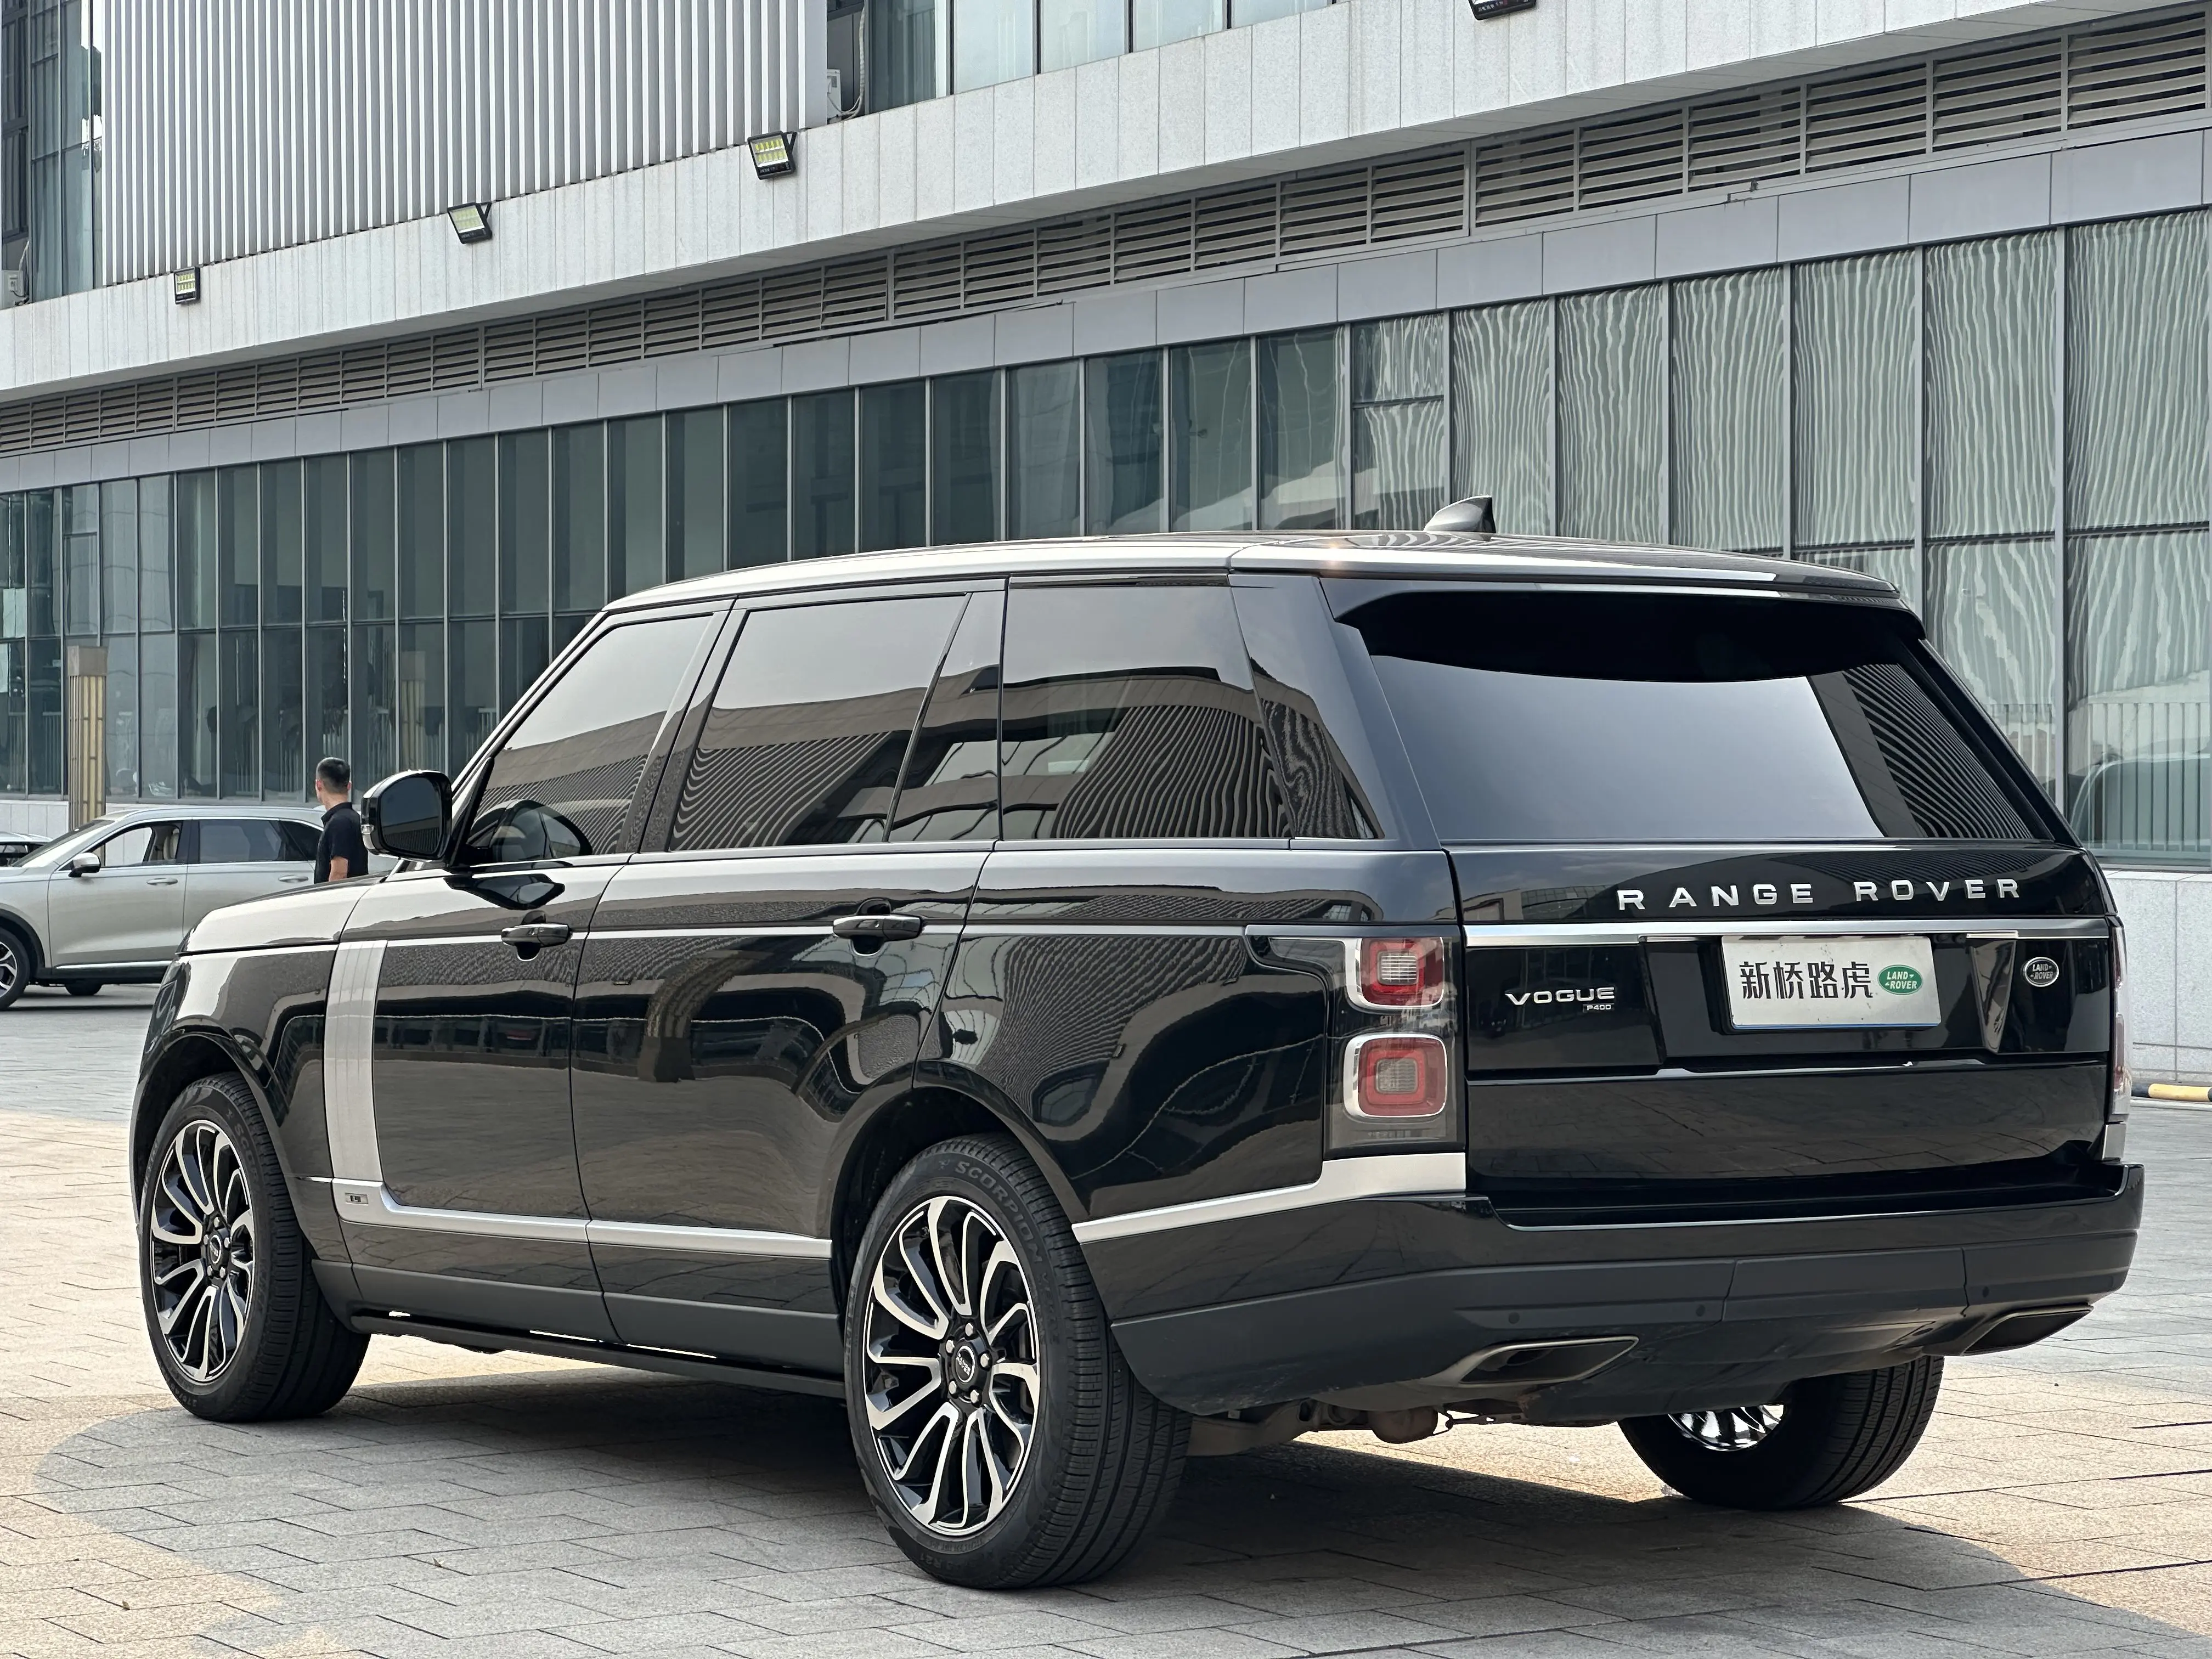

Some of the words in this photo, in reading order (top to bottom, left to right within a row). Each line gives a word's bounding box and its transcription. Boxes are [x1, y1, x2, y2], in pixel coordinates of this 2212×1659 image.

[1617, 883, 1813, 910] RANGE
[1854, 878, 2020, 902] ROVER
[1887, 971, 1909, 980] LAND
[2032, 963, 2049, 972] LAND
[1739, 961, 1873, 999] 新桥路虎
[1889, 980, 1917, 989] ROVER
[1505, 987, 1615, 1006] VOGUE
[955, 1161, 1043, 1263] SCORPION
